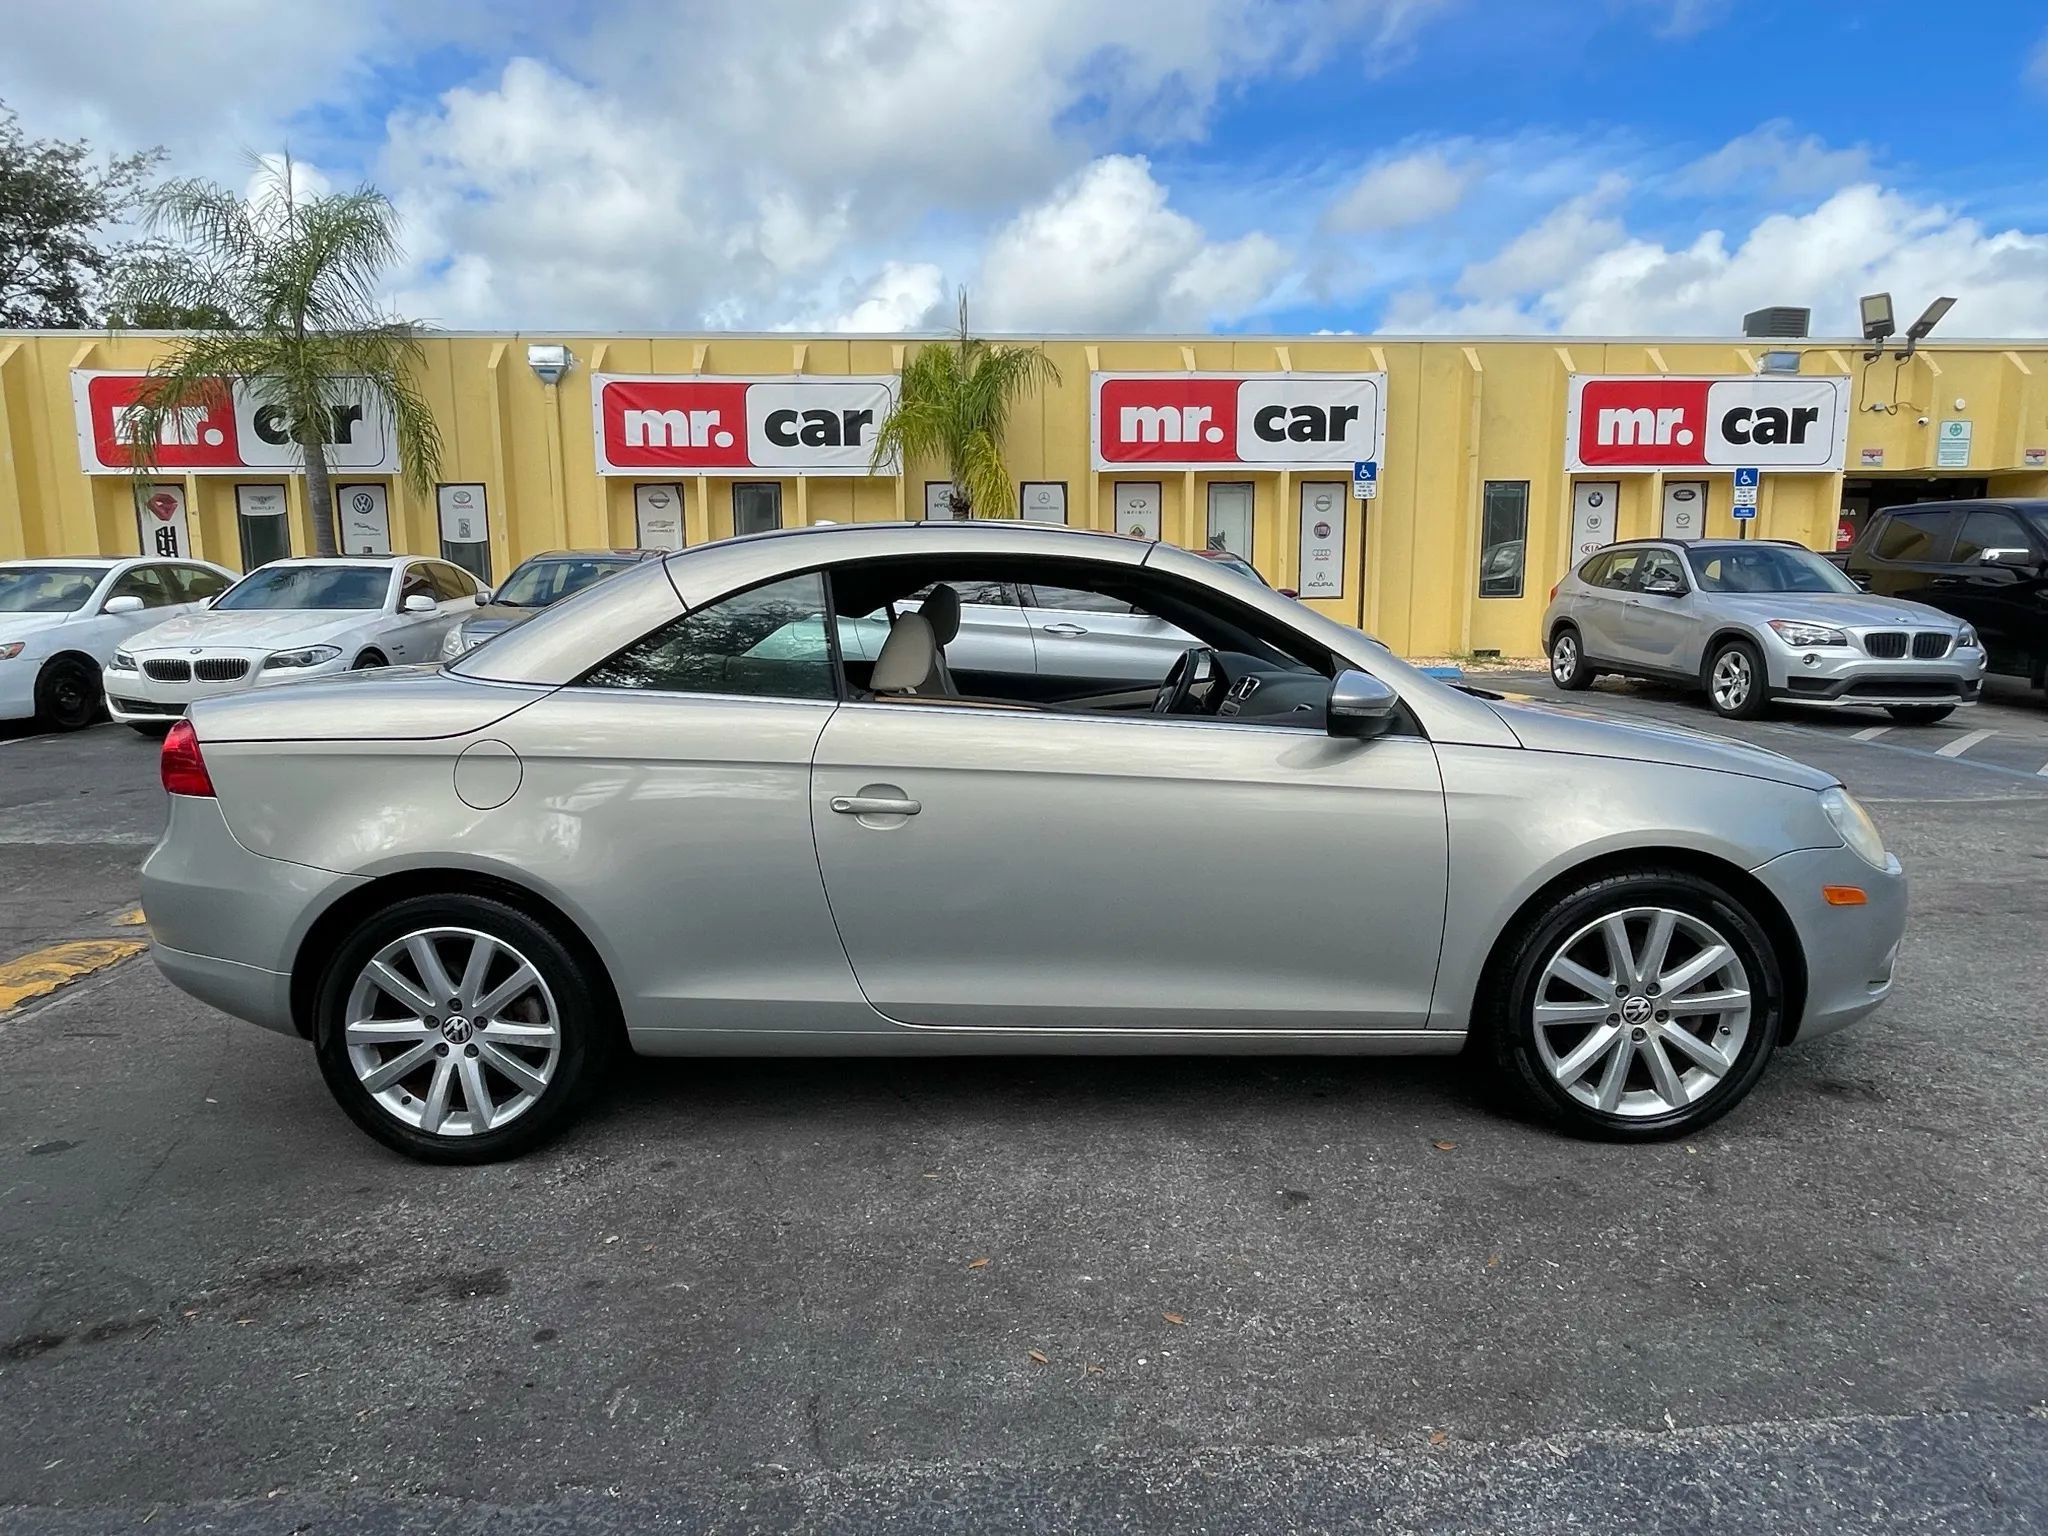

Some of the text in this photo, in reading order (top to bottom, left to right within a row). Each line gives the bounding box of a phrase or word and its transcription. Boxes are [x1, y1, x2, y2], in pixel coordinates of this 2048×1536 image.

[624, 408, 873, 448] mr. car
[1120, 404, 1359, 444] mr. car
[1597, 406, 1819, 446] mr. car
